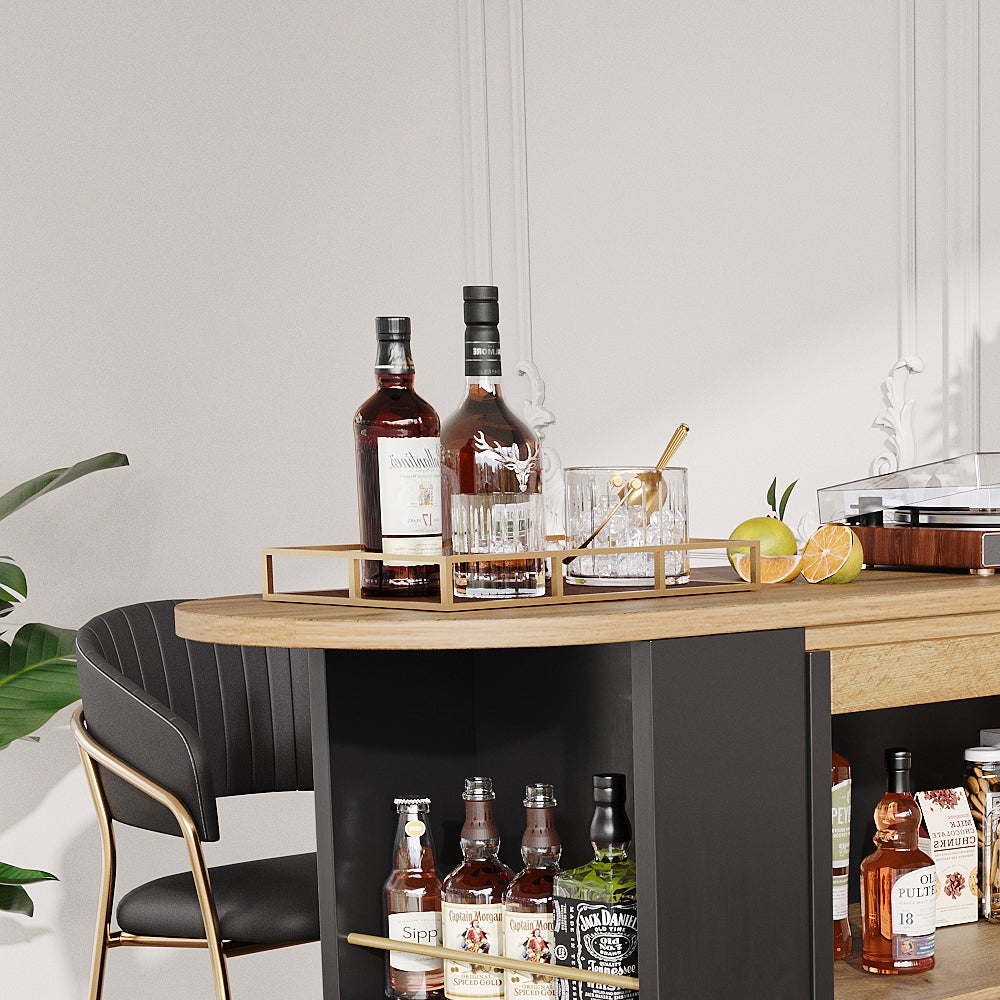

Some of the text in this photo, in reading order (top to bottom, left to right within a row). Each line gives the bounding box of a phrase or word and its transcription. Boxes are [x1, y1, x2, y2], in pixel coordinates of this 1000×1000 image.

[449, 910, 502, 923] Captain Morgan
[580, 913, 601, 931] JACK
[900, 913, 913, 925] 18
[510, 919, 554, 932] Captain Morg
[403, 926, 438, 942] Sipp
